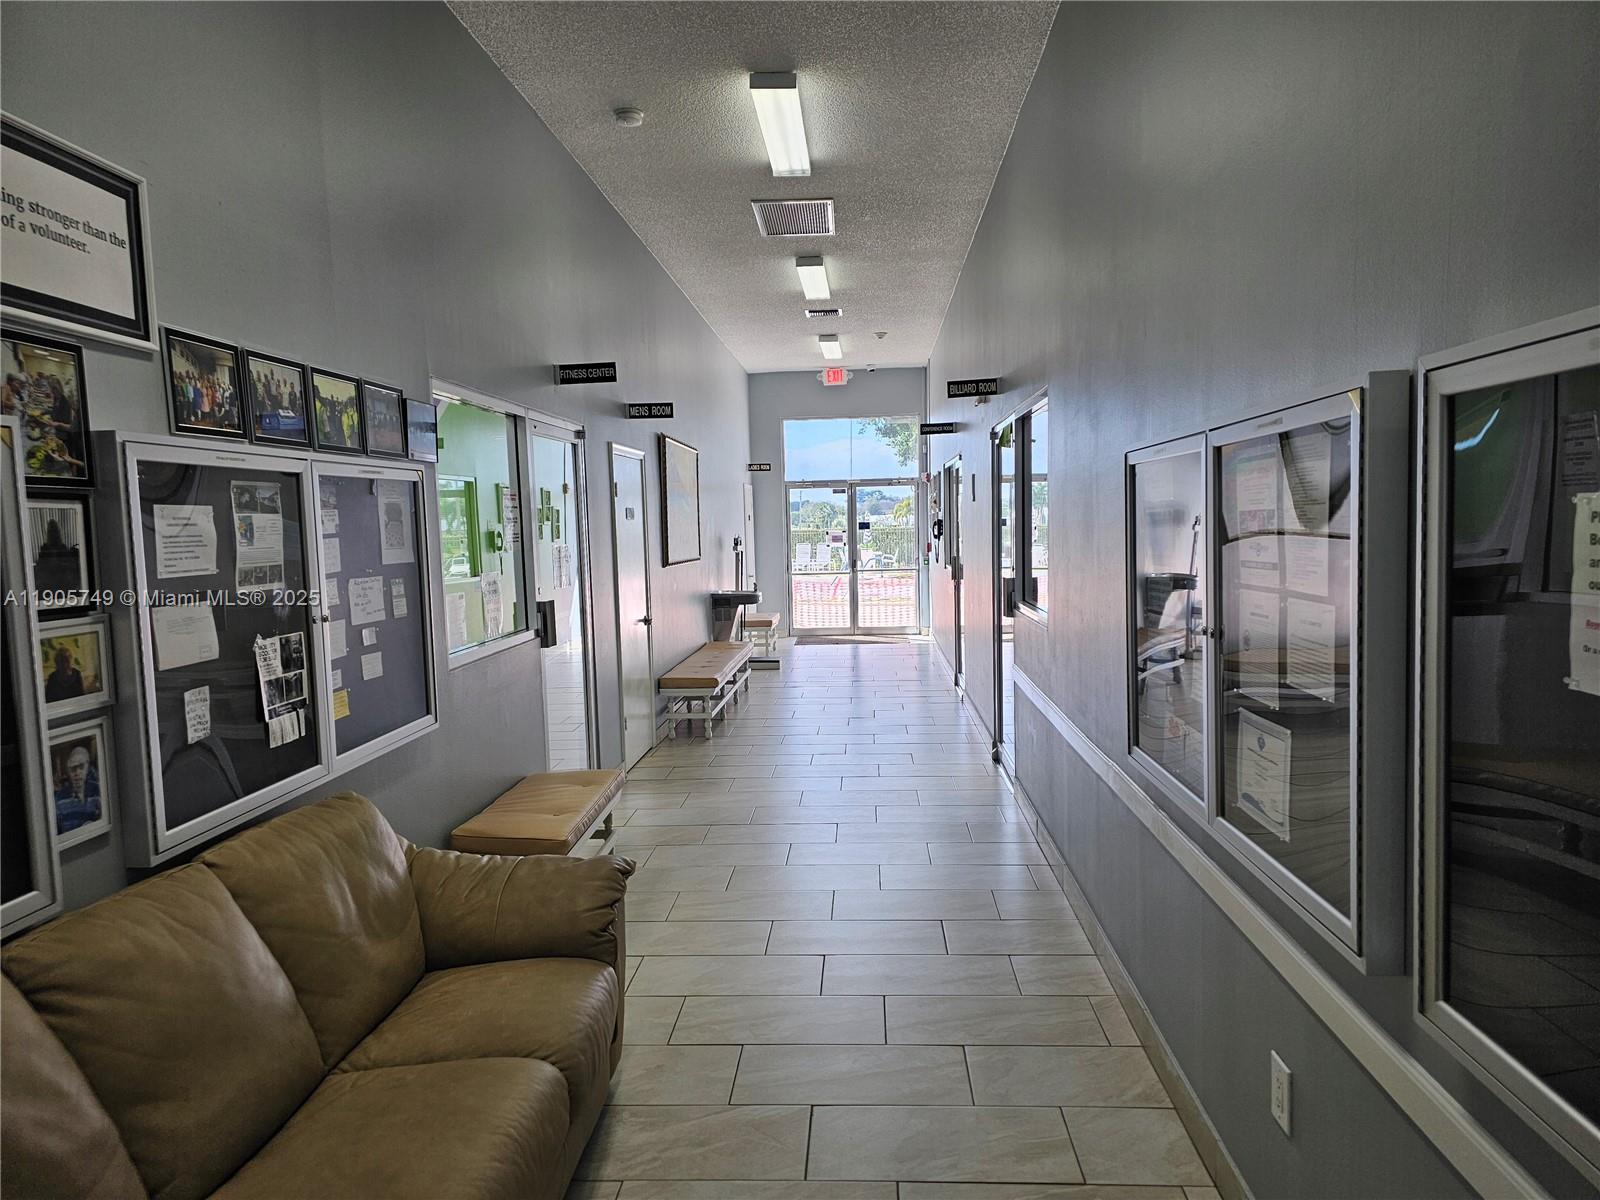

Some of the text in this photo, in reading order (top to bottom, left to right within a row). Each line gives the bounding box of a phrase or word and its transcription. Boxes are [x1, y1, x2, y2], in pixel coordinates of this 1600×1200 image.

[1, 187, 127, 249] ing stronger than the
[1, 214, 91, 254] of a volunteer.
[560, 367, 615, 379] FITNESS CENTER
[827, 369, 843, 383] EXIT
[949, 382, 997, 395] BILLIARD ROOM
[630, 405, 671, 416] MENS ROOM
